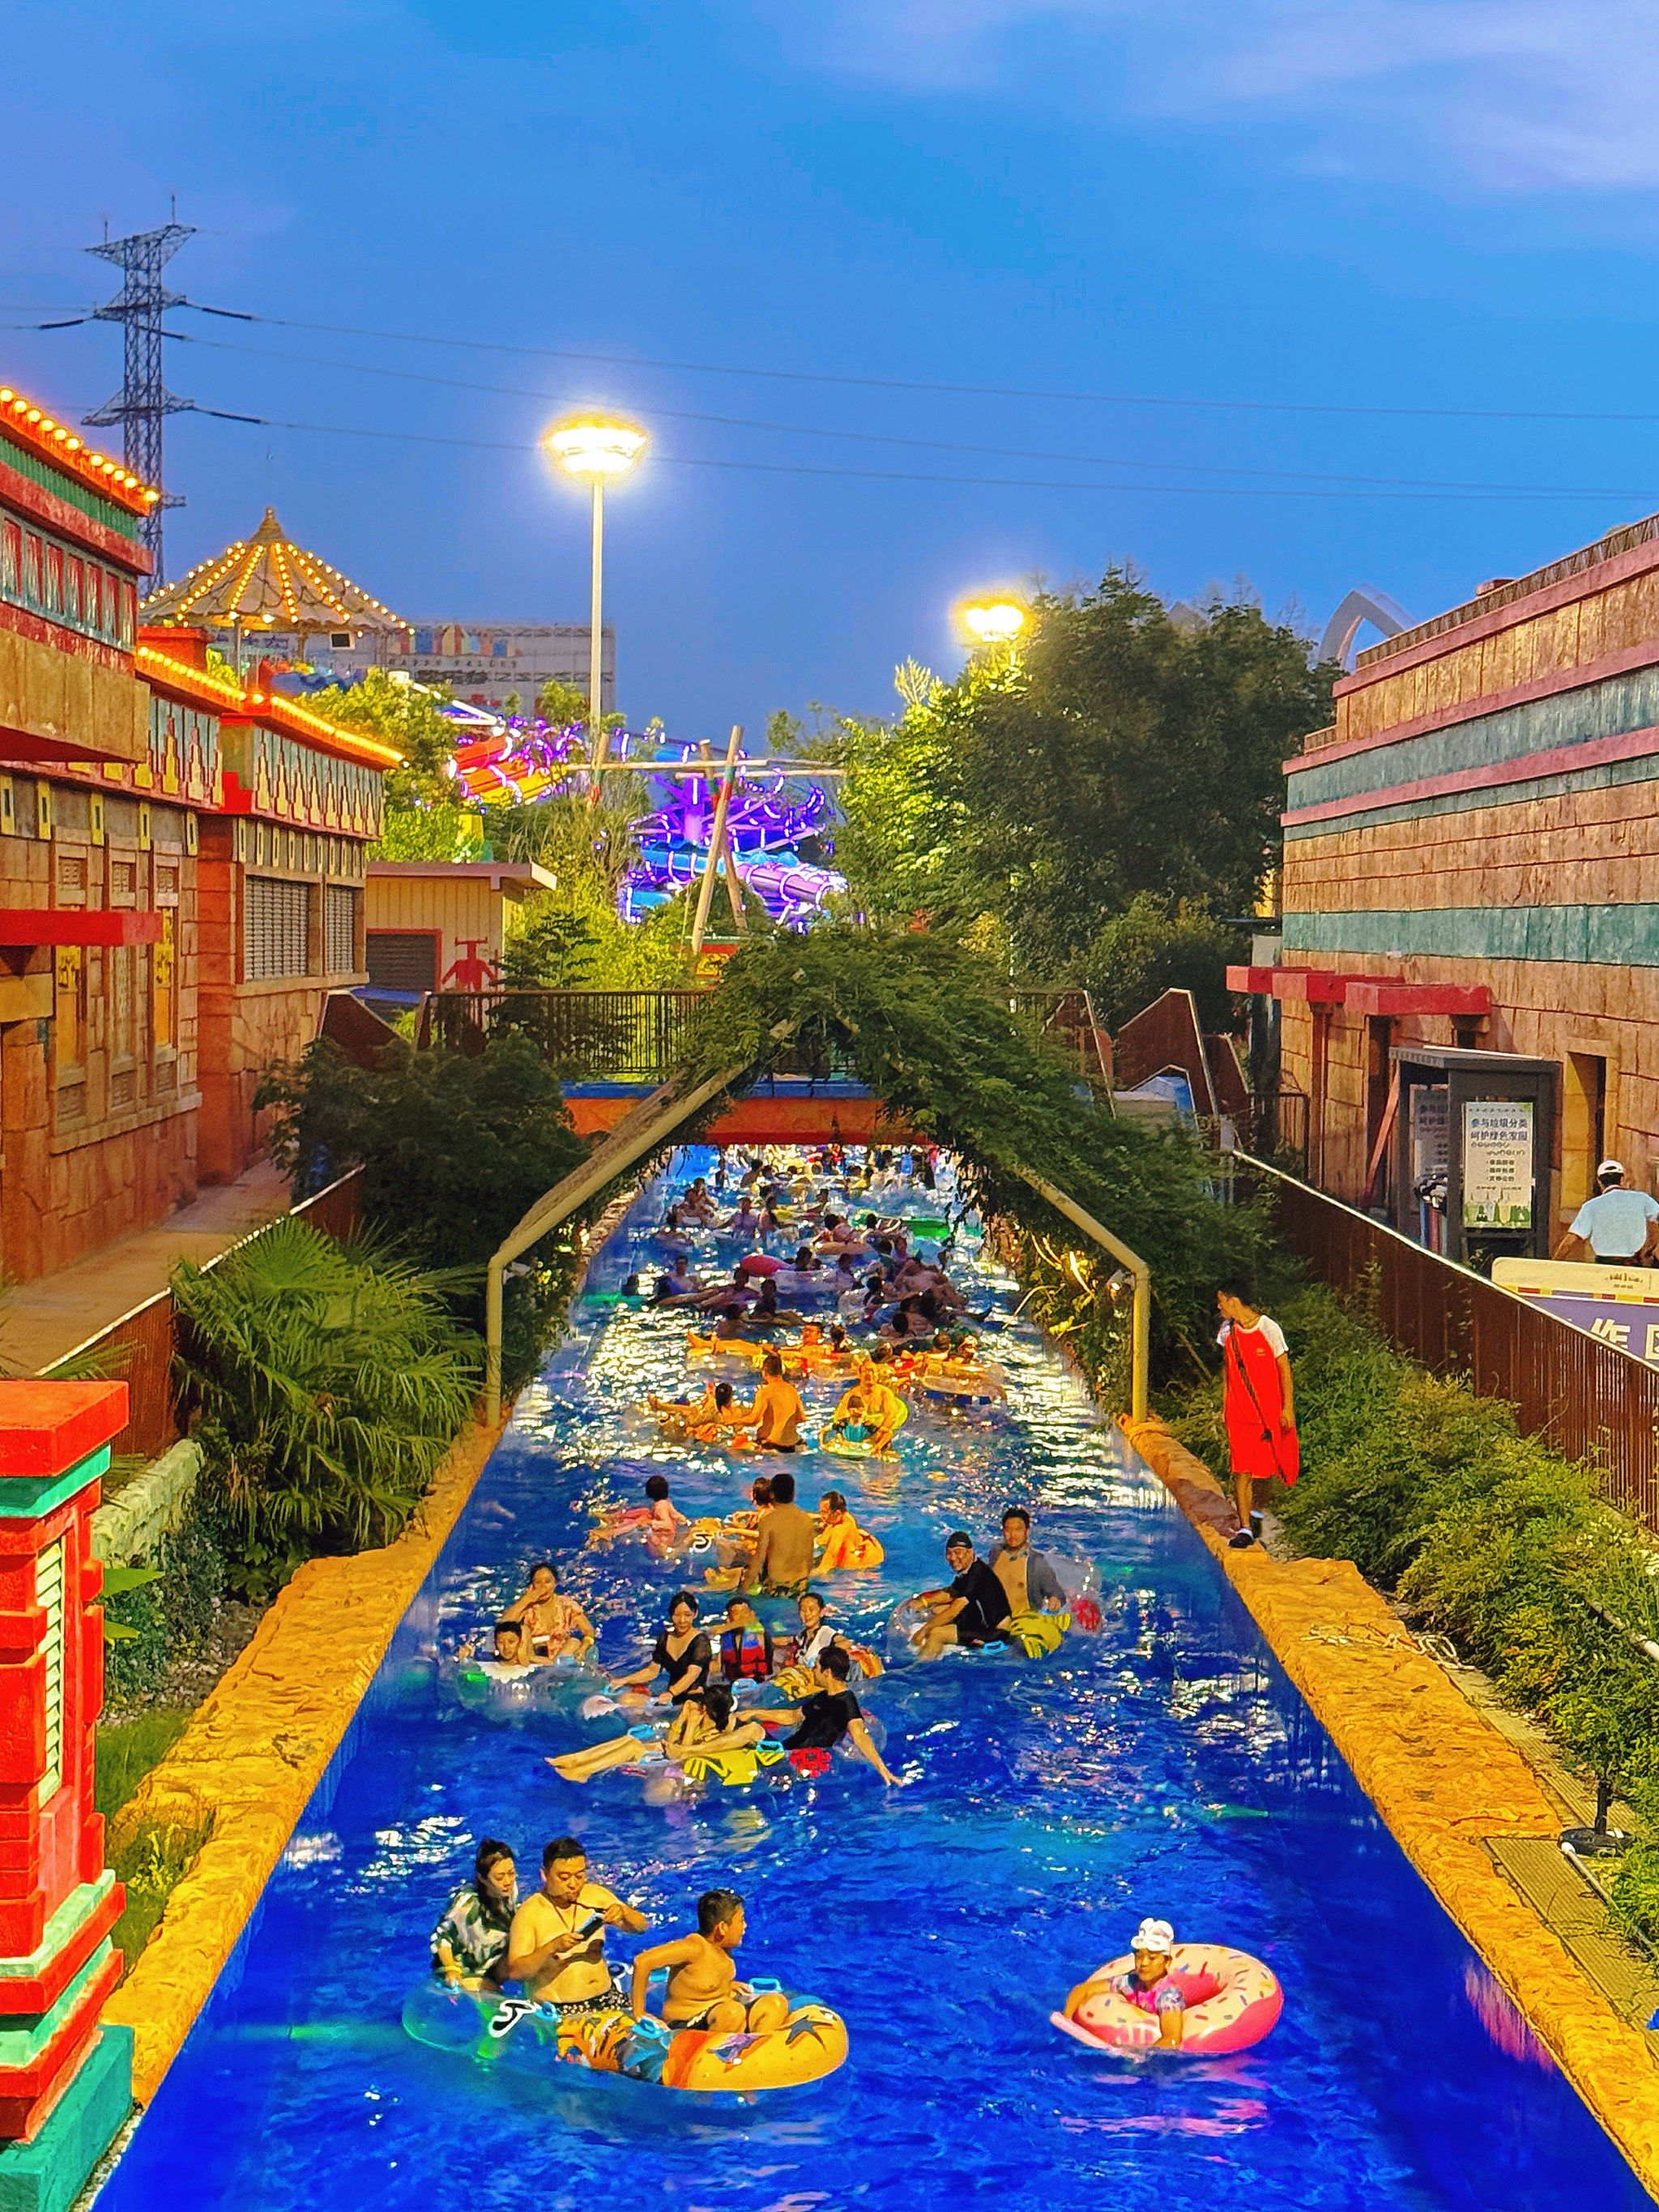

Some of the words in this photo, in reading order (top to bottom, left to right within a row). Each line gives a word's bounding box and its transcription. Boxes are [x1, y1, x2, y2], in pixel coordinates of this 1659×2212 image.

[1470, 1118, 1528, 1128] 参与垃圾分类
